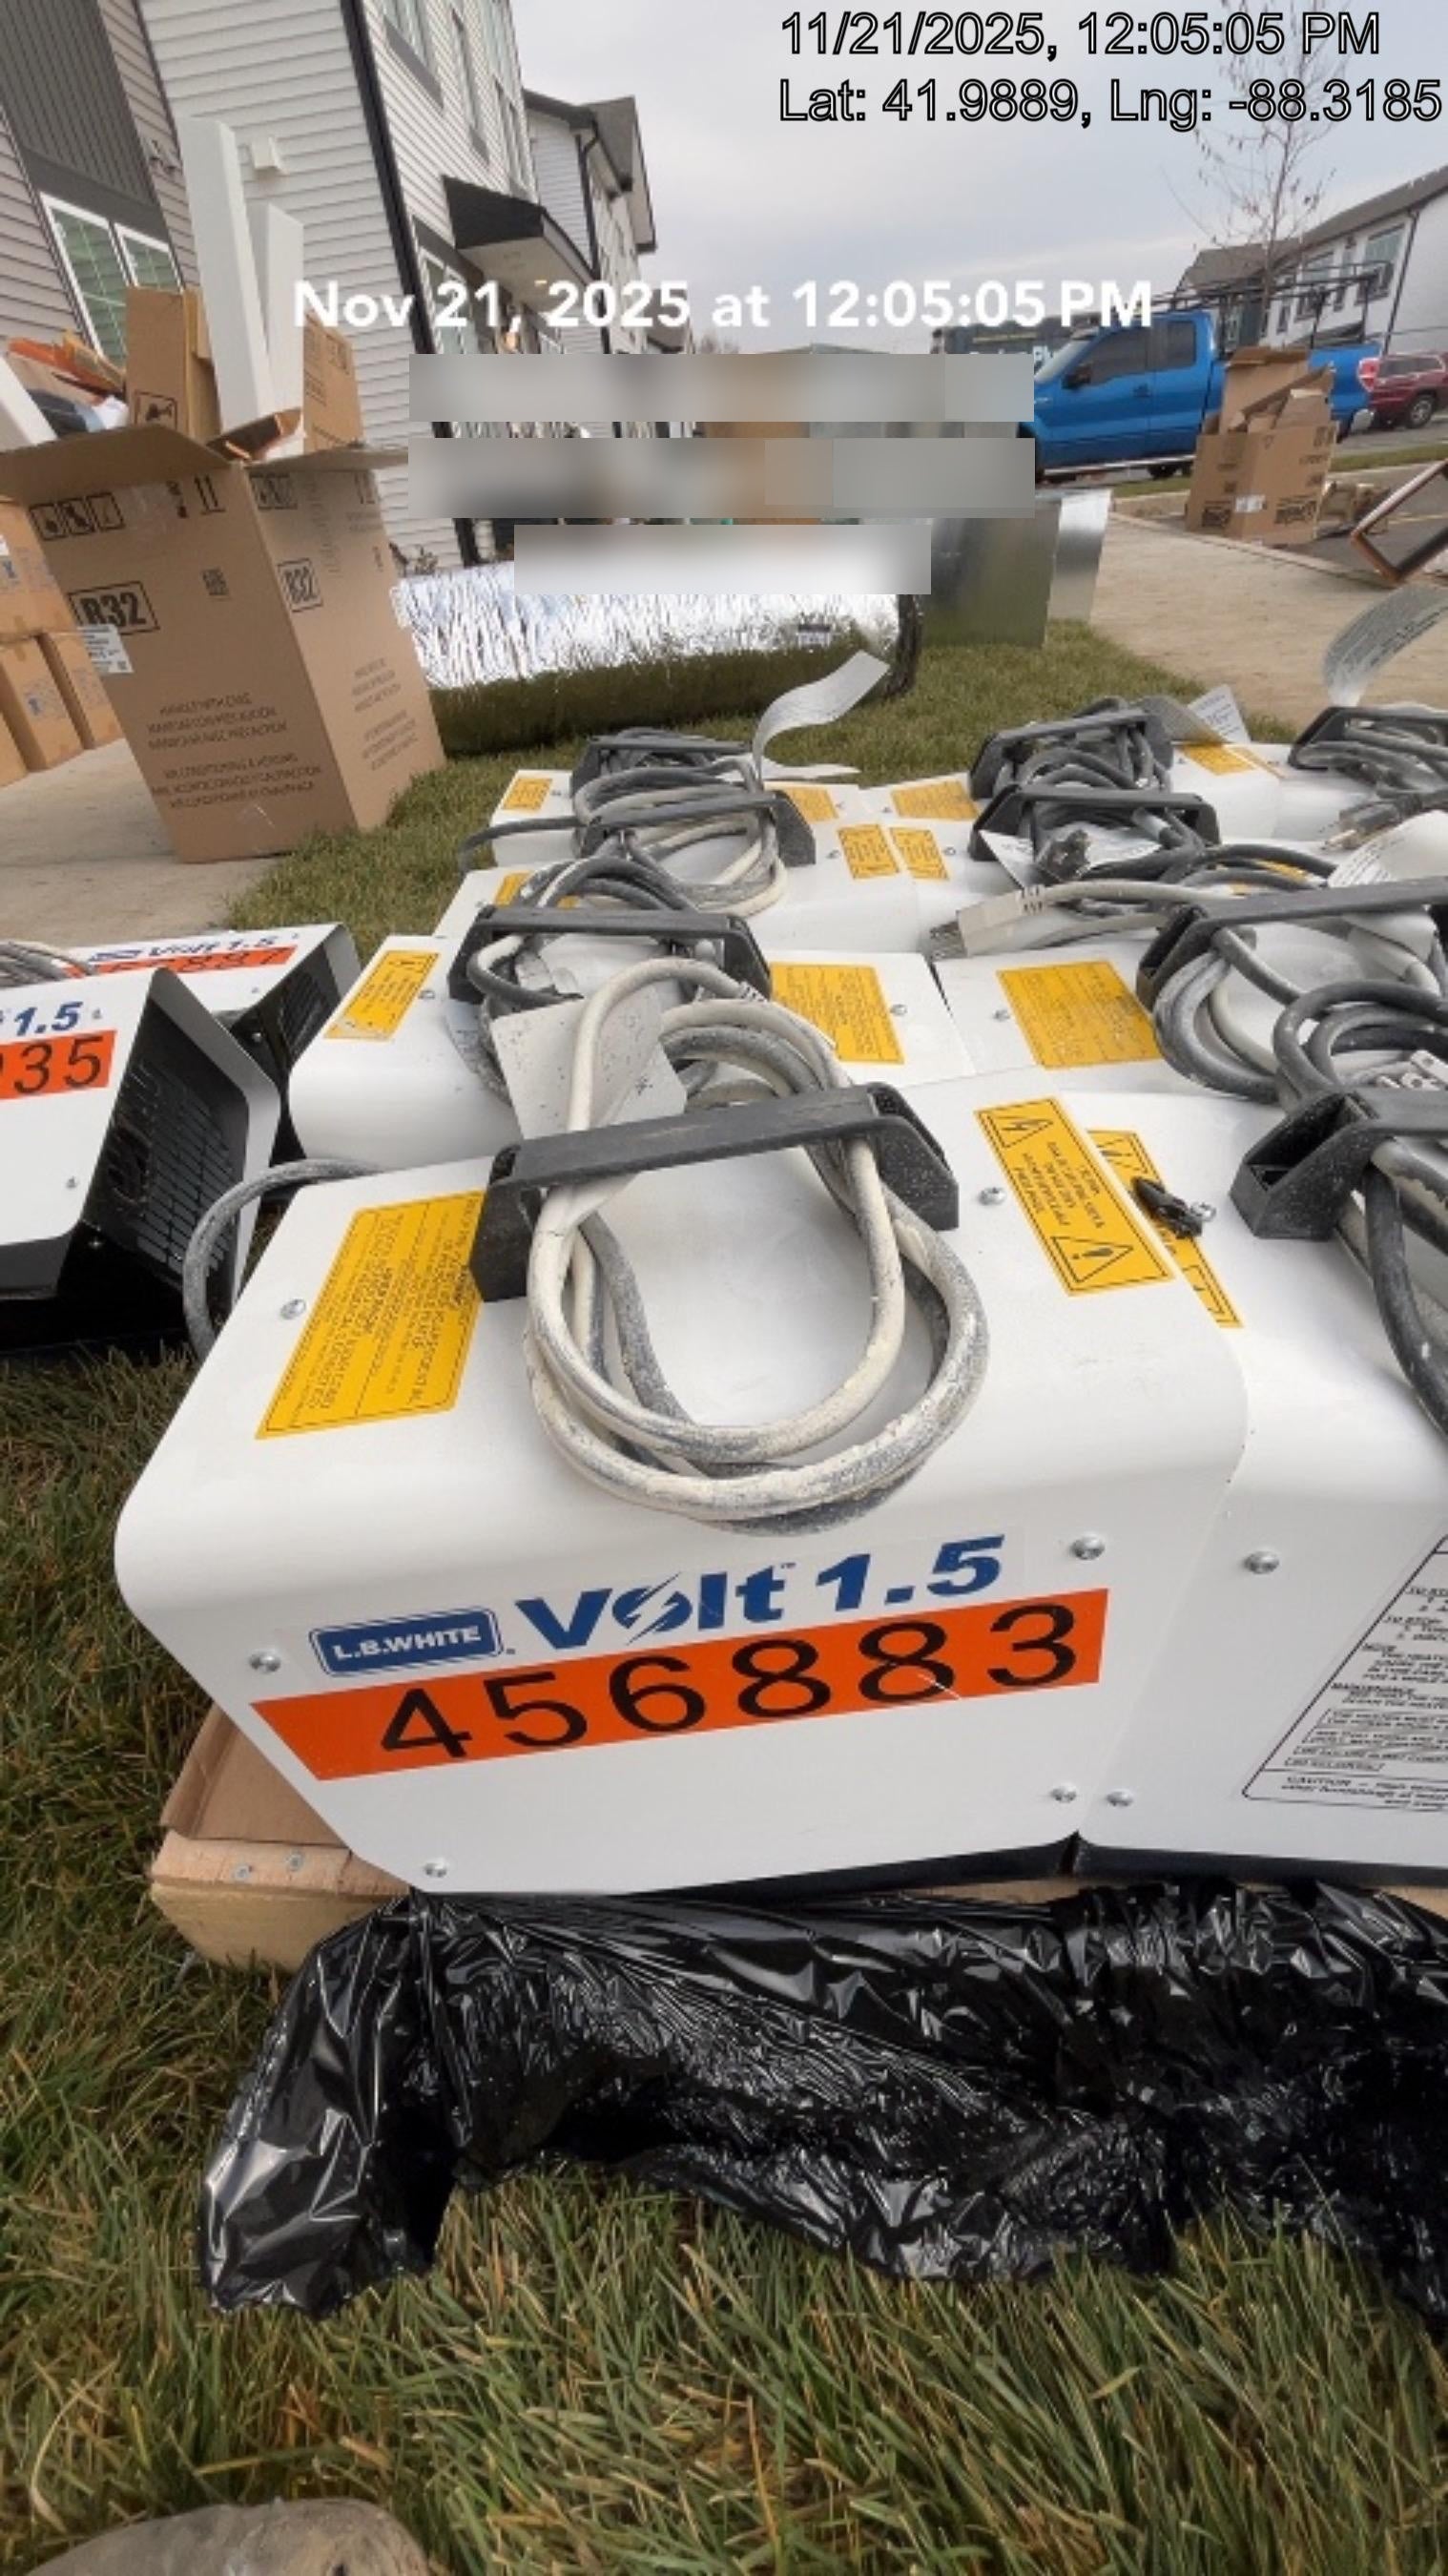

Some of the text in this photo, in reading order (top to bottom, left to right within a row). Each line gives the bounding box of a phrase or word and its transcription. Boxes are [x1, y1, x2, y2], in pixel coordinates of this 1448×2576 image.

[79, 592, 146, 627] R32
[14, 1001, 84, 1036] 1.5
[0, 1036, 103, 1094] 35
[514, 1534, 1005, 1650] Volt 1.5
[381, 1604, 1077, 1758] 456883
